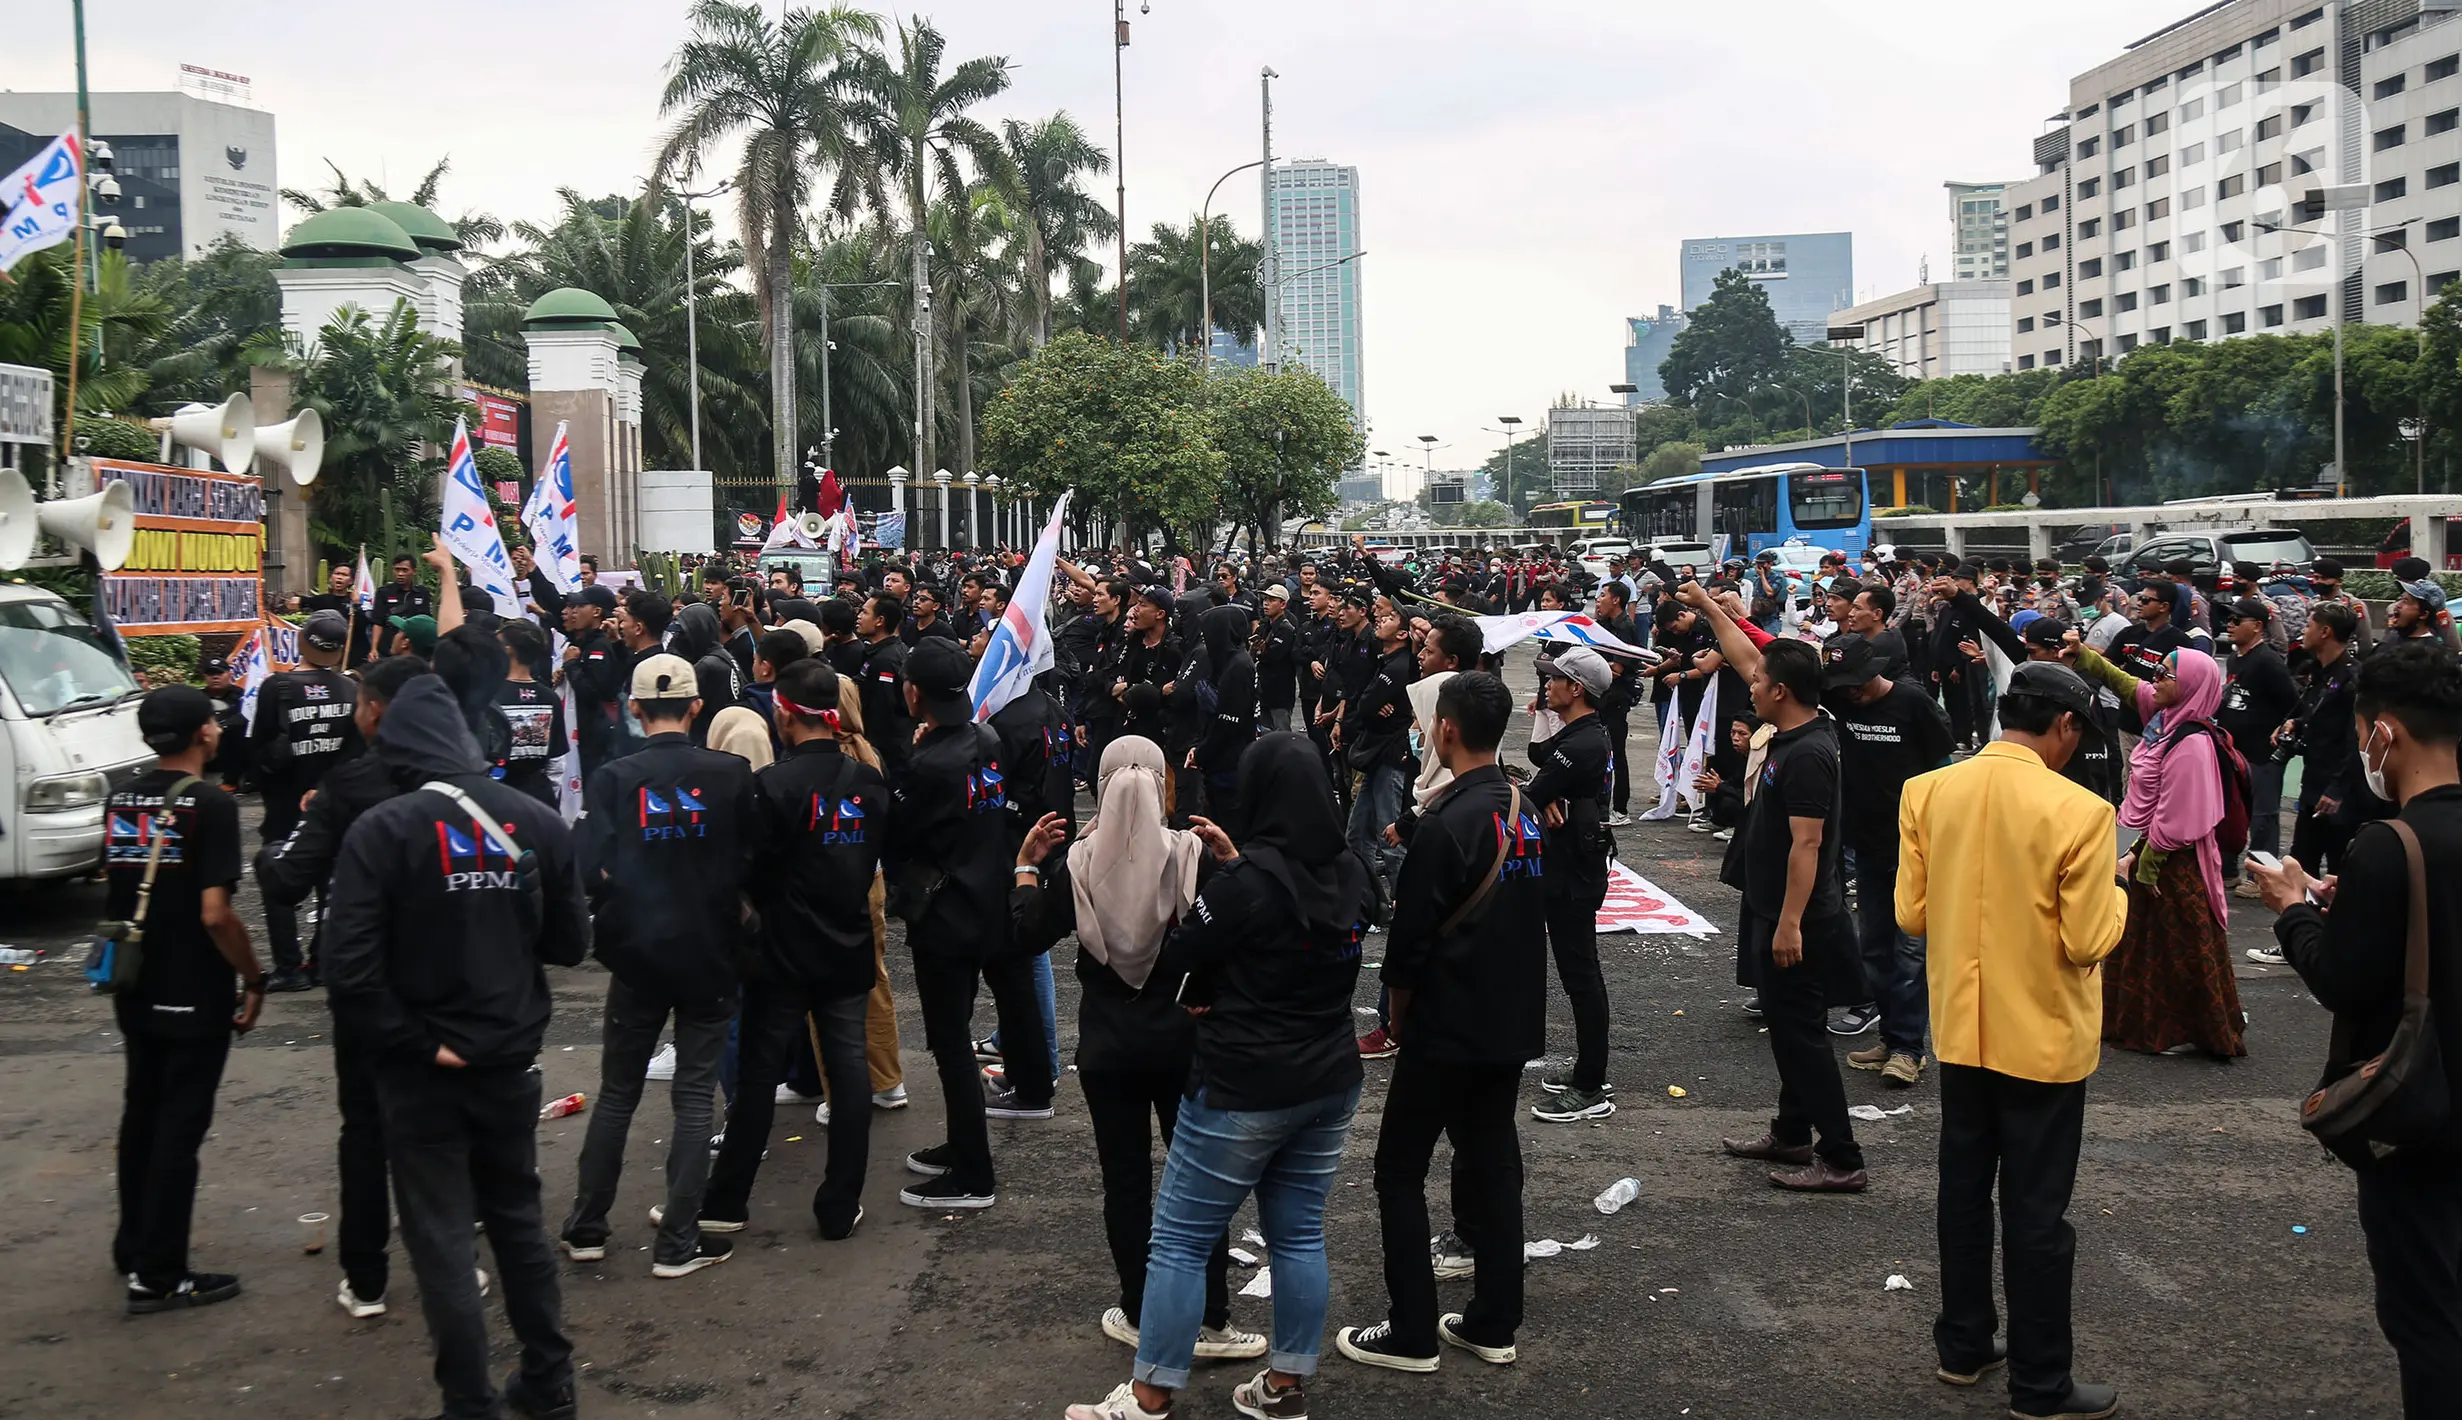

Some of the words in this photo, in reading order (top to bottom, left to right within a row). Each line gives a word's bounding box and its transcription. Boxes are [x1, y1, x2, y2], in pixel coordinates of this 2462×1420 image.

[1689, 243, 1728, 255] DIPO
[180, 531, 259, 573] MUNDUR
[443, 870, 520, 892] PPM
